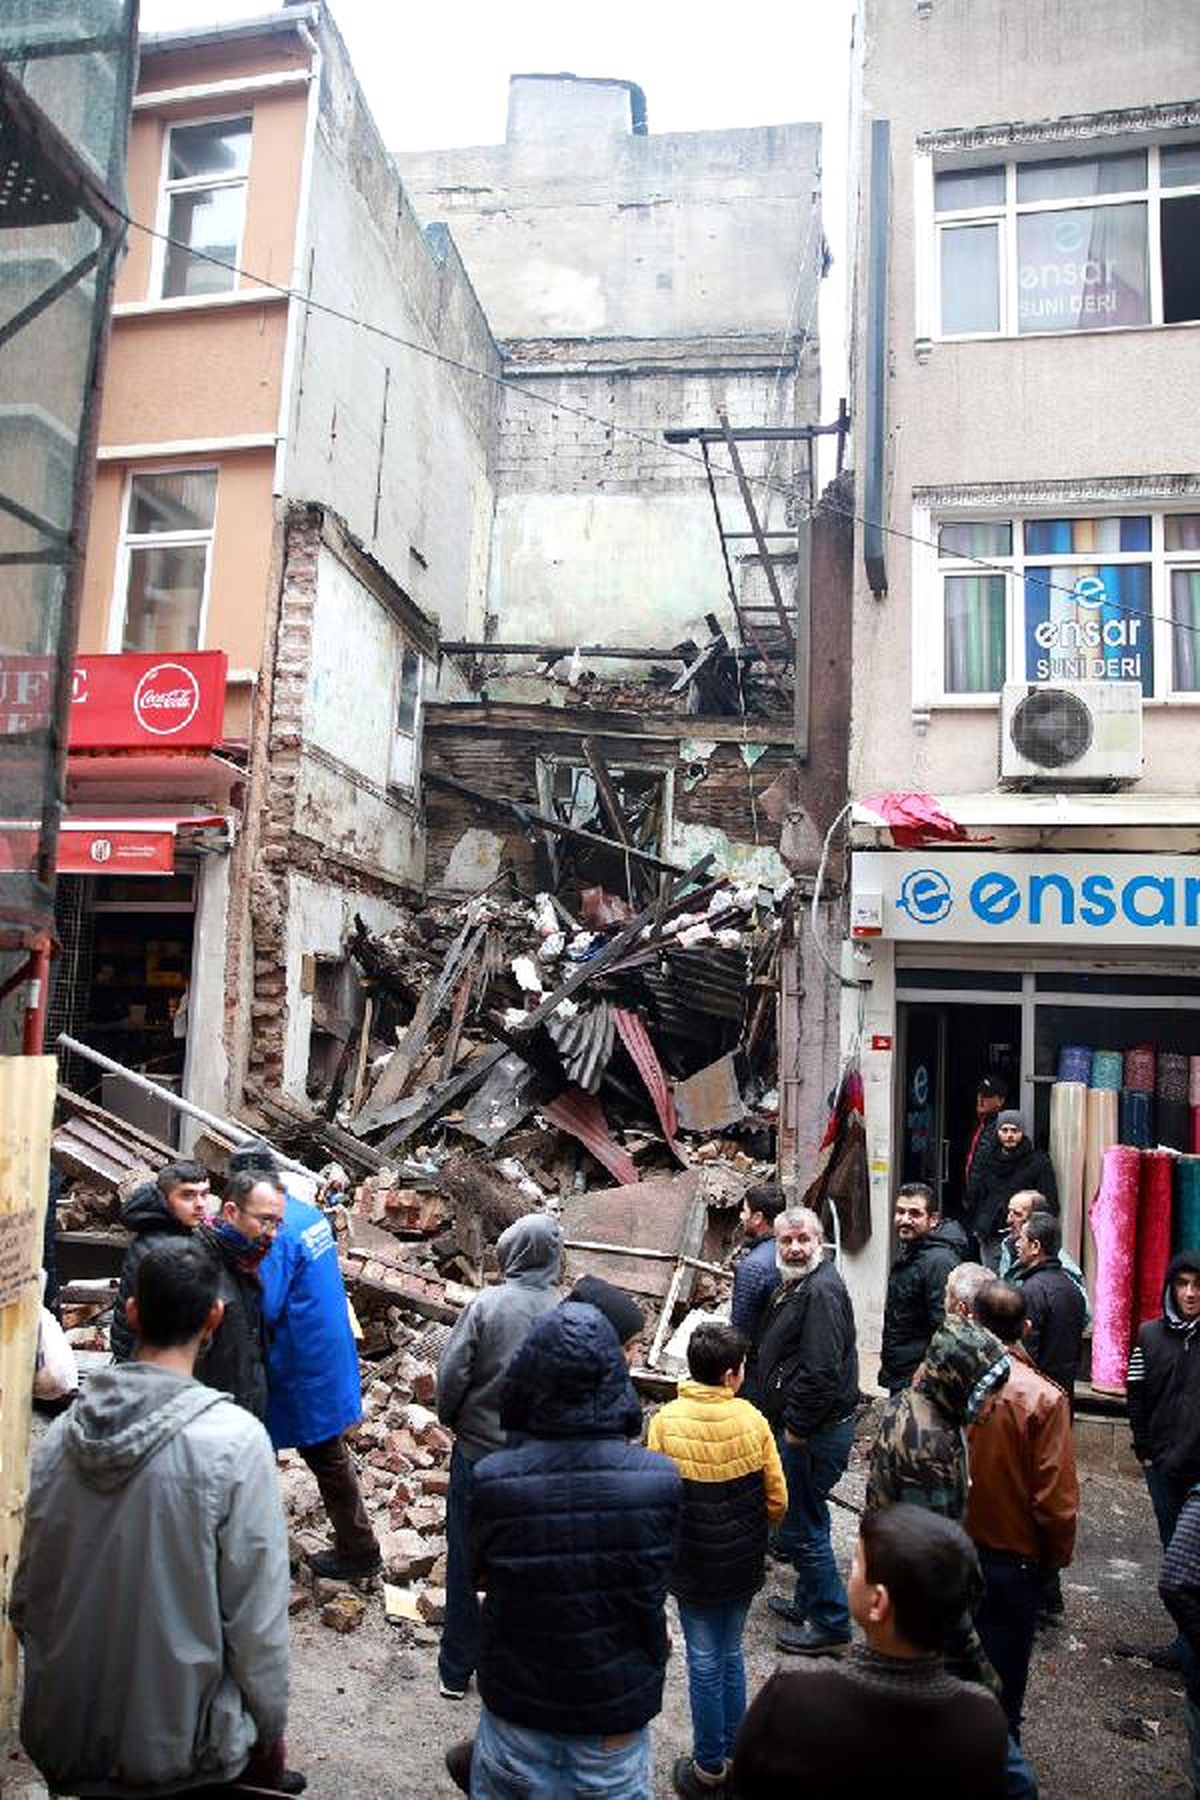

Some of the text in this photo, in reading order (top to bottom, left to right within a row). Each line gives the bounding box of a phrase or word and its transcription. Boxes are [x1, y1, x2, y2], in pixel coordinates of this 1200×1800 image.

[1019, 258, 1119, 289] ensar
[1035, 619, 1141, 649] ensar
[1092, 653, 1141, 678] DERİ
